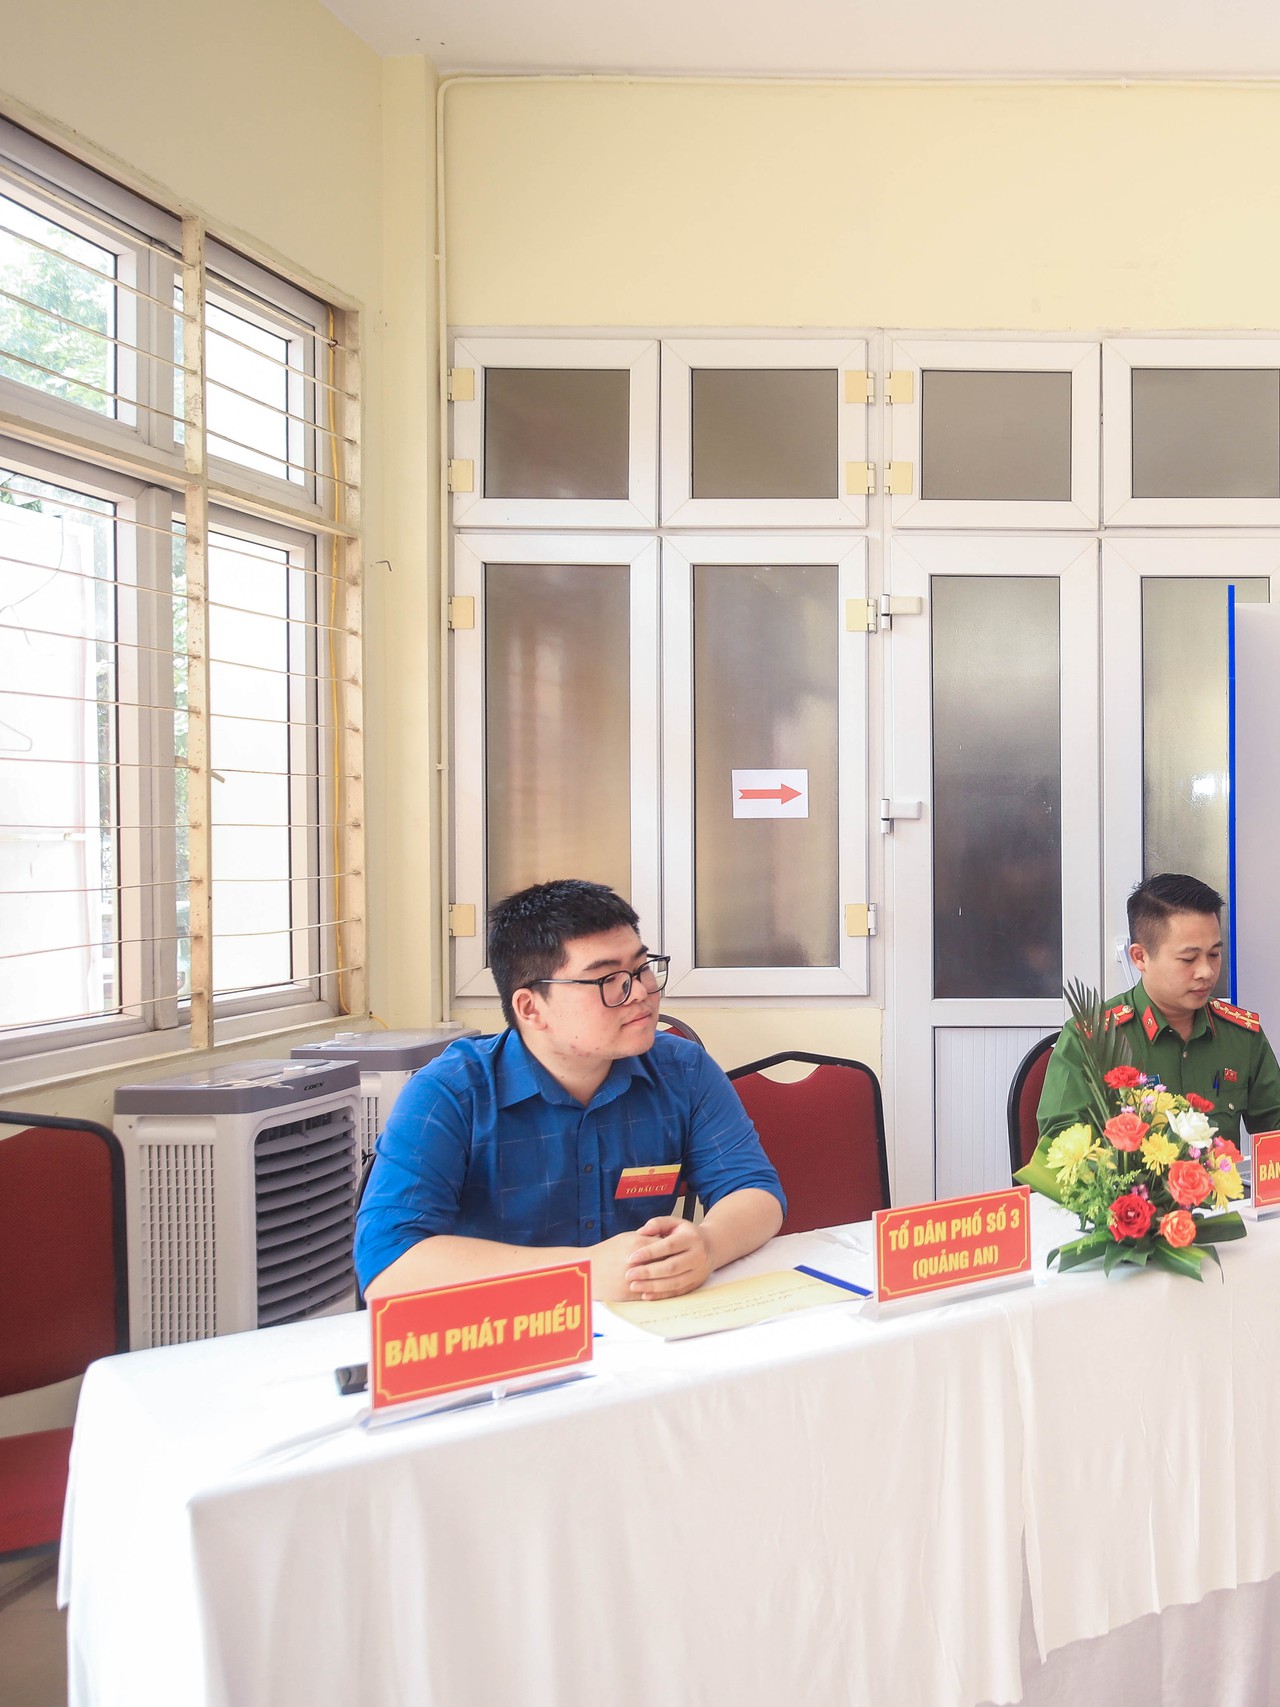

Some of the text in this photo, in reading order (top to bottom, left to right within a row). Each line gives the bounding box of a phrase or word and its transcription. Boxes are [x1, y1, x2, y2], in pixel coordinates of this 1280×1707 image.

[889, 1203, 1020, 1251] TỔ DÂN PHỐ SỐ 3
[912, 1245, 999, 1280] (QUẢNG AN)
[385, 1299, 581, 1368] BÀN PHÁT PHIẾU
